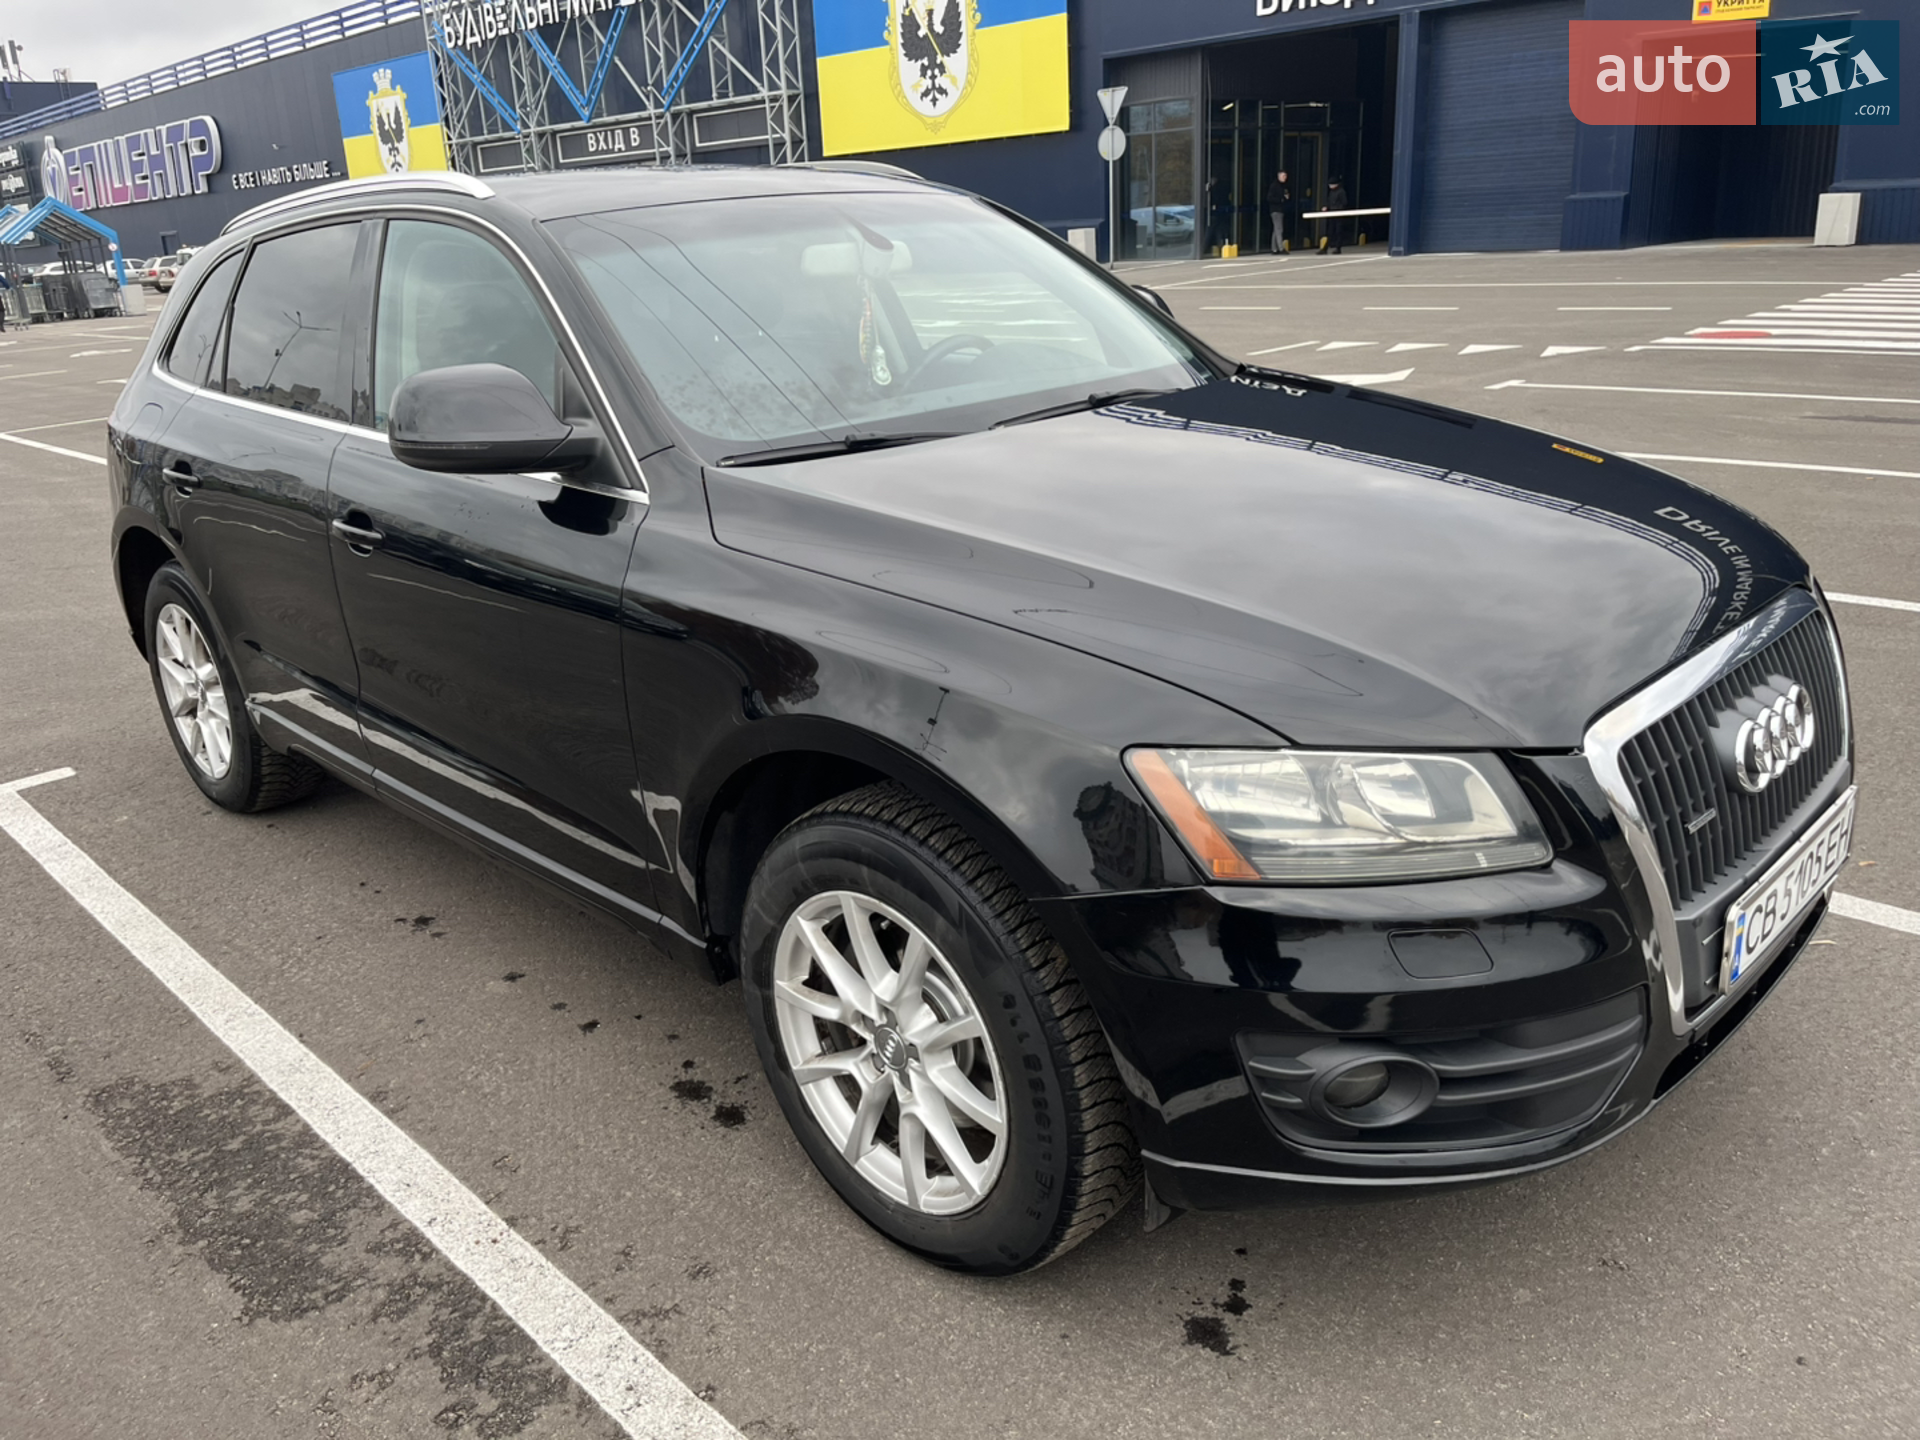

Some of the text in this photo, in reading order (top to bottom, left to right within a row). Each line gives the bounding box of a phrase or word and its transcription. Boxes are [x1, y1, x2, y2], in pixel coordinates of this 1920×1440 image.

[63, 115, 222, 211] ЕПІЦЕНТР
[587, 127, 641, 152] ВХІД В
[238, 171, 256, 189] ВСЕ
[260, 166, 293, 185] НАВІТЬ
[292, 160, 330, 181] БІЛЬШЕ
[1746, 888, 1777, 955] CB
[1779, 836, 1825, 922] 5105
